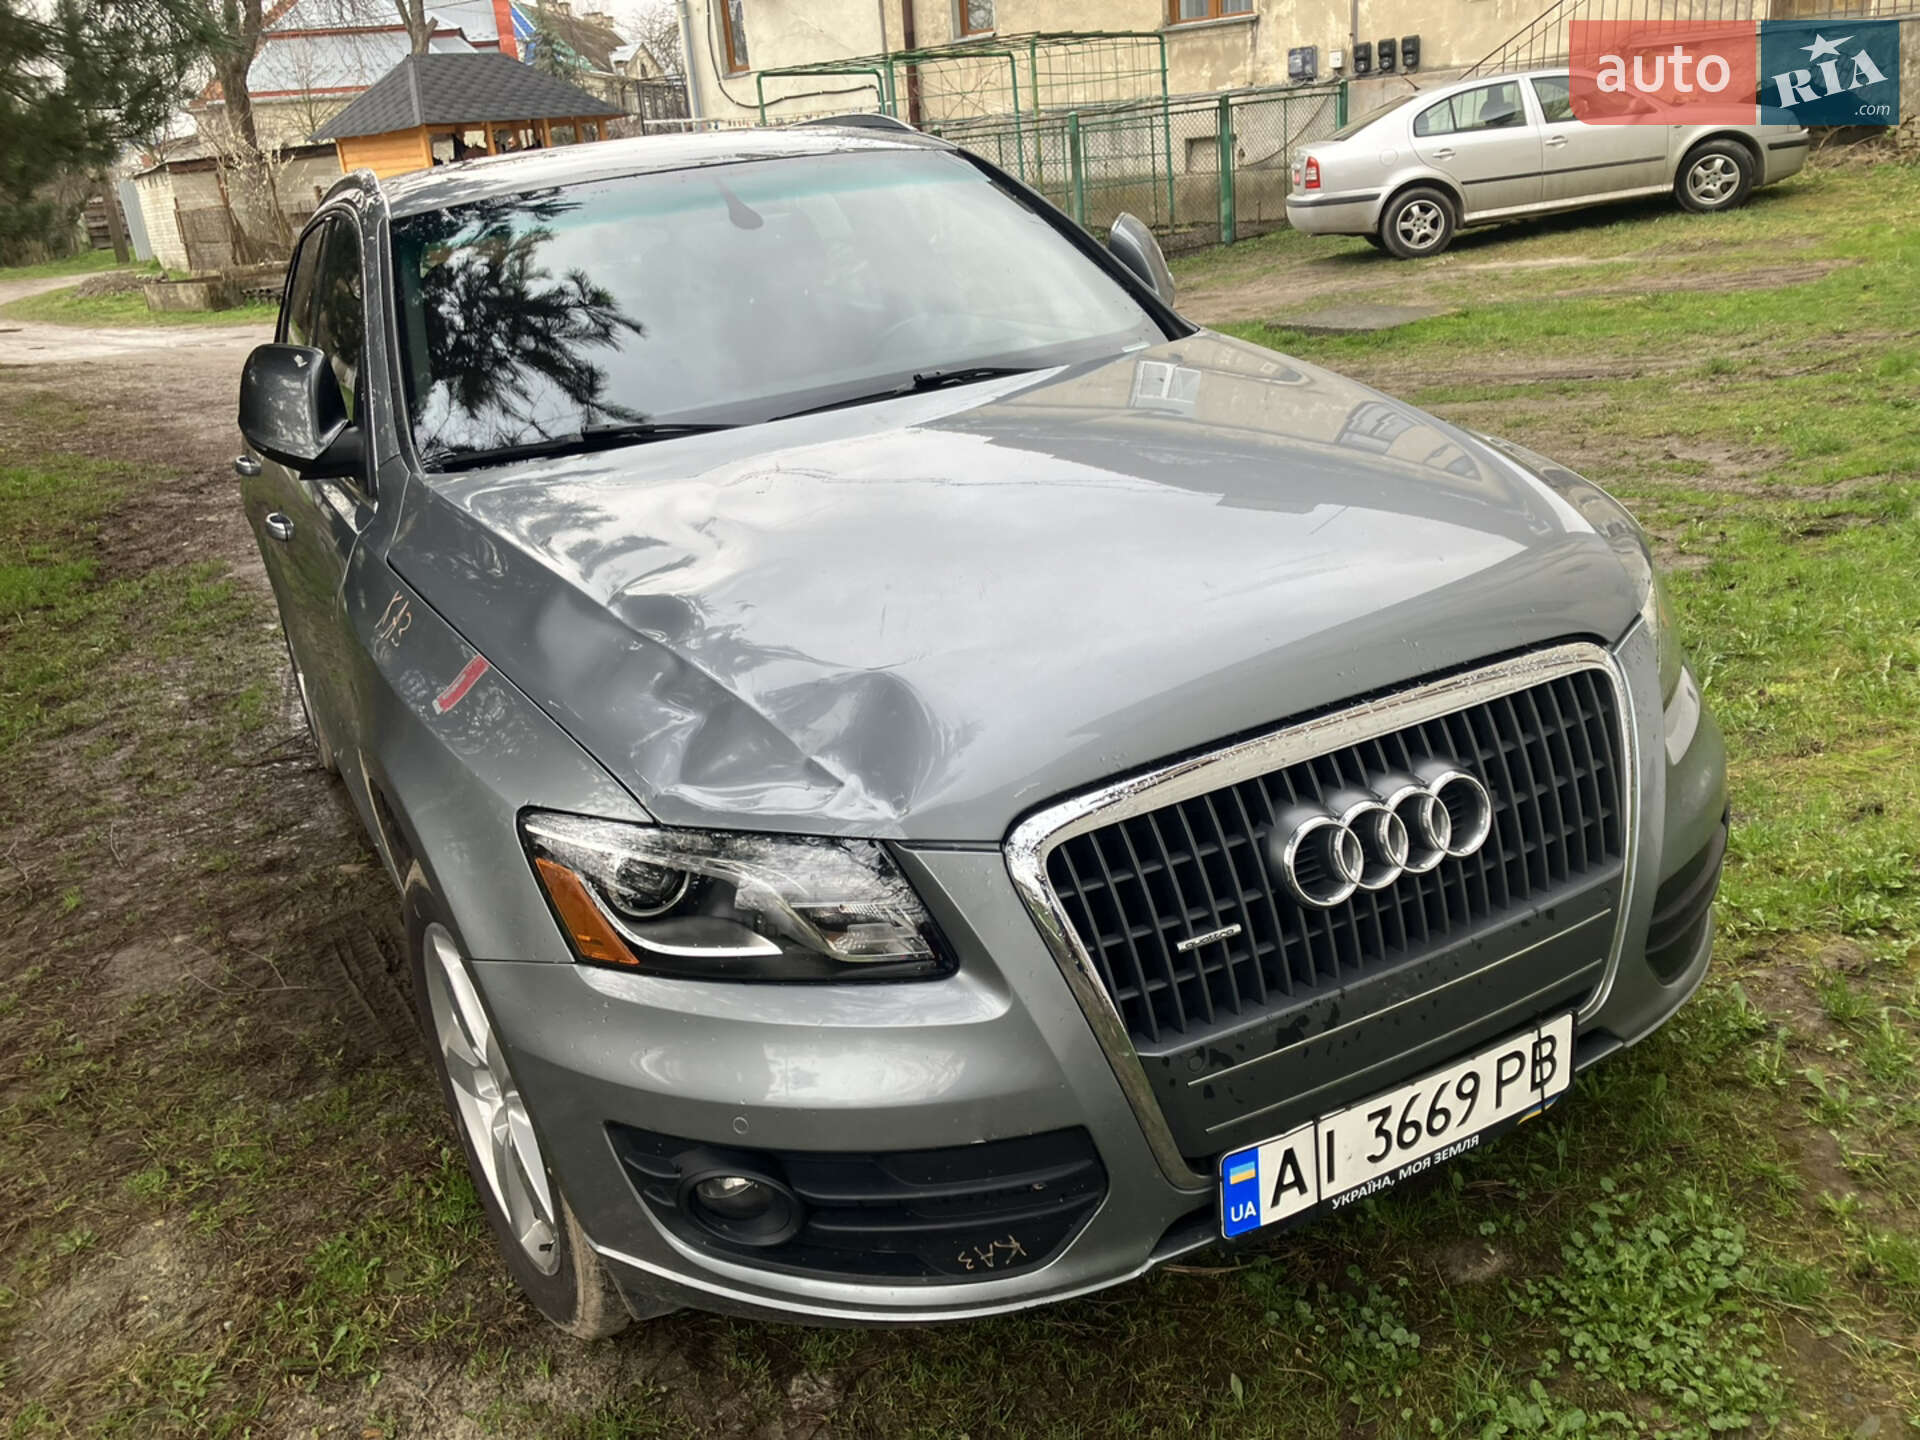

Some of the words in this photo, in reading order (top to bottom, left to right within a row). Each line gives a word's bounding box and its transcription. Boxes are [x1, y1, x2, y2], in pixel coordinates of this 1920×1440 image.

[1269, 1129, 1336, 1209] AI
[1365, 1070, 1481, 1165] 3669
[1494, 1034, 1558, 1110] PB
[1331, 1175, 1396, 1210] УКРАЇНА,
[1398, 1156, 1432, 1181] МОЯ
[1434, 1134, 1480, 1165] ЗЕМЛЯ
[1230, 1200, 1257, 1223] UA
